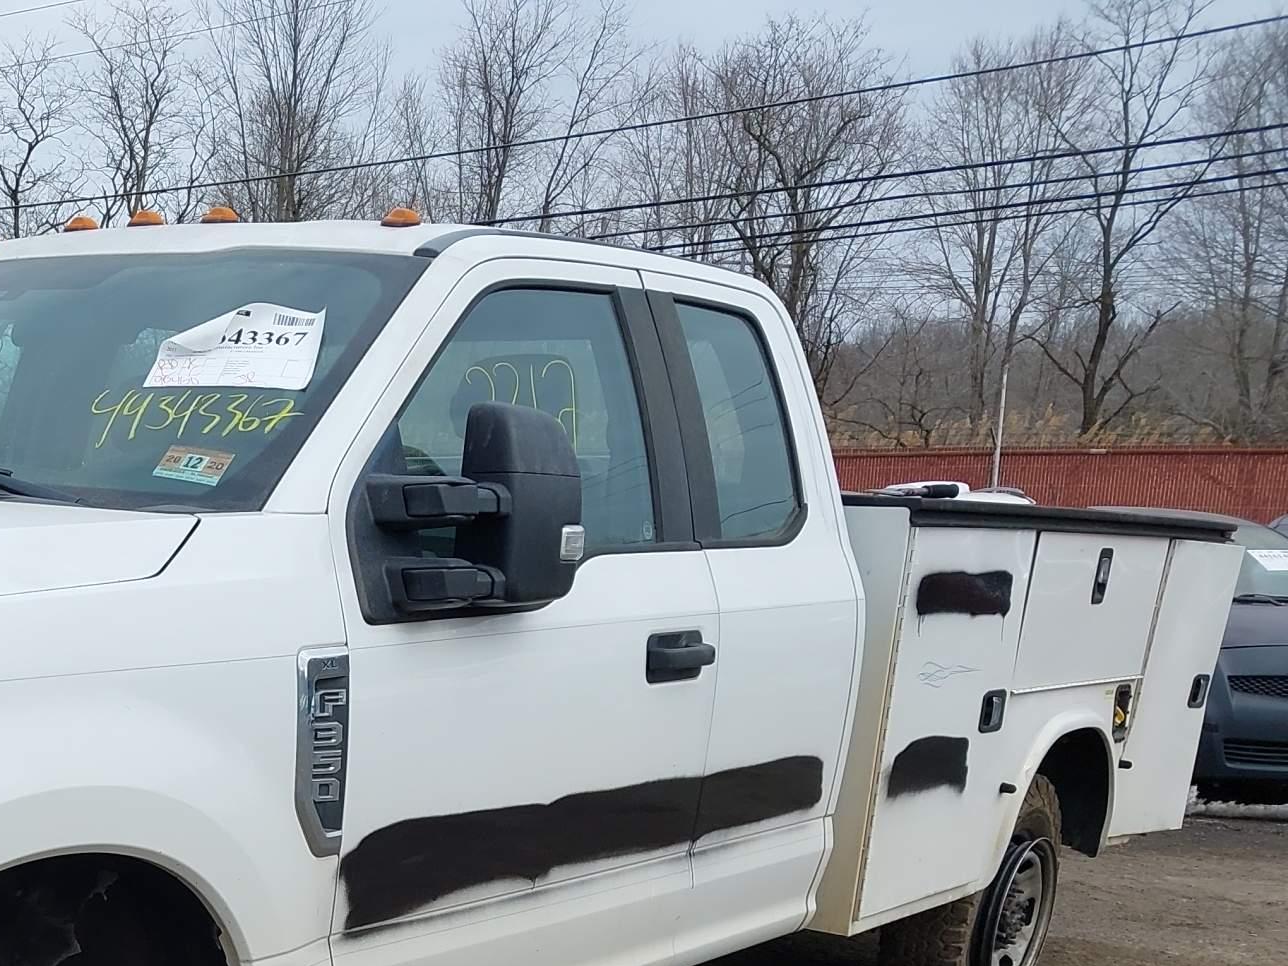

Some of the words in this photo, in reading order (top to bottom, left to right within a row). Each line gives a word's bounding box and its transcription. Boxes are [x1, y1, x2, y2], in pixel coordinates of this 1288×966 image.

[218, 327, 309, 347] 43367
[183, 455, 204, 469] 12
[322, 659, 339, 672] XL
